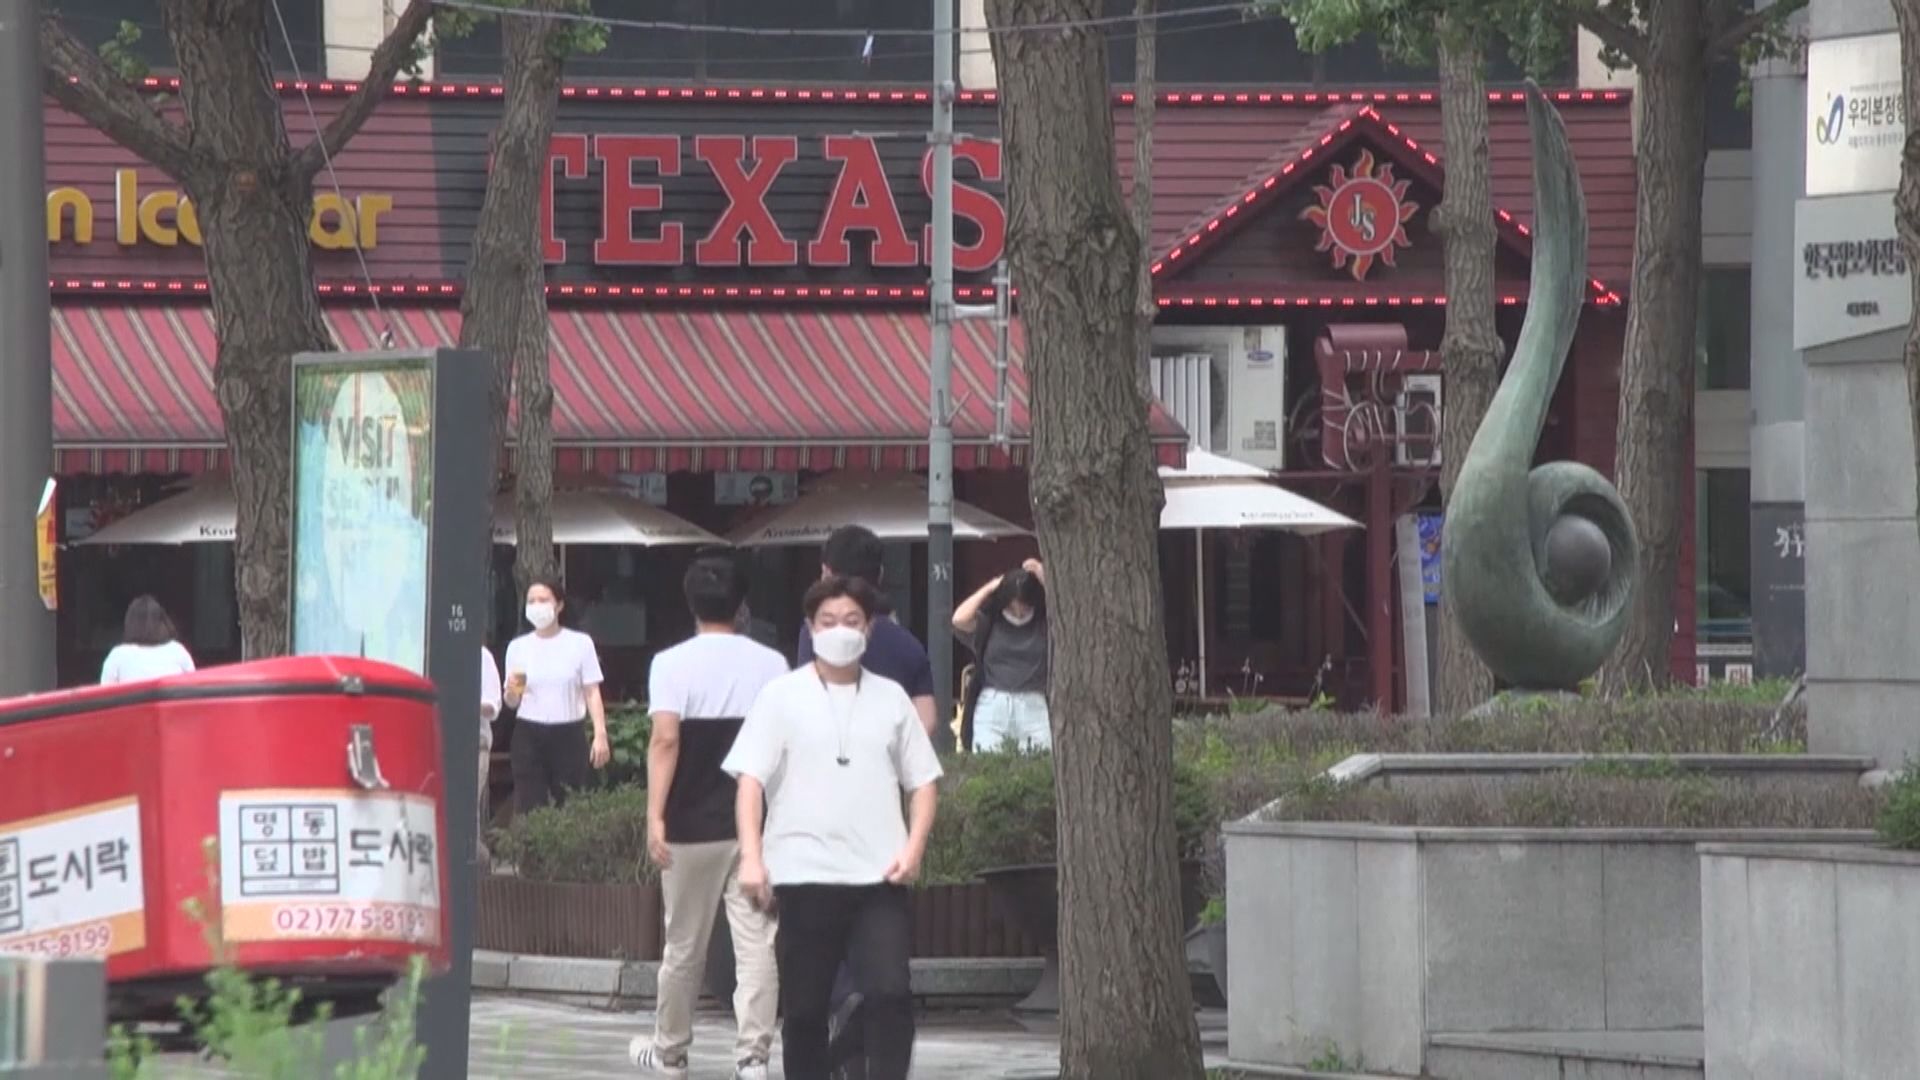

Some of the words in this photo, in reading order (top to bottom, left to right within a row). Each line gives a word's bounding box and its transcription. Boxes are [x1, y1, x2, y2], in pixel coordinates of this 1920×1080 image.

[310, 193, 392, 248] ar
[337, 416, 397, 469] VISIT
[28, 837, 130, 898] 도시락
